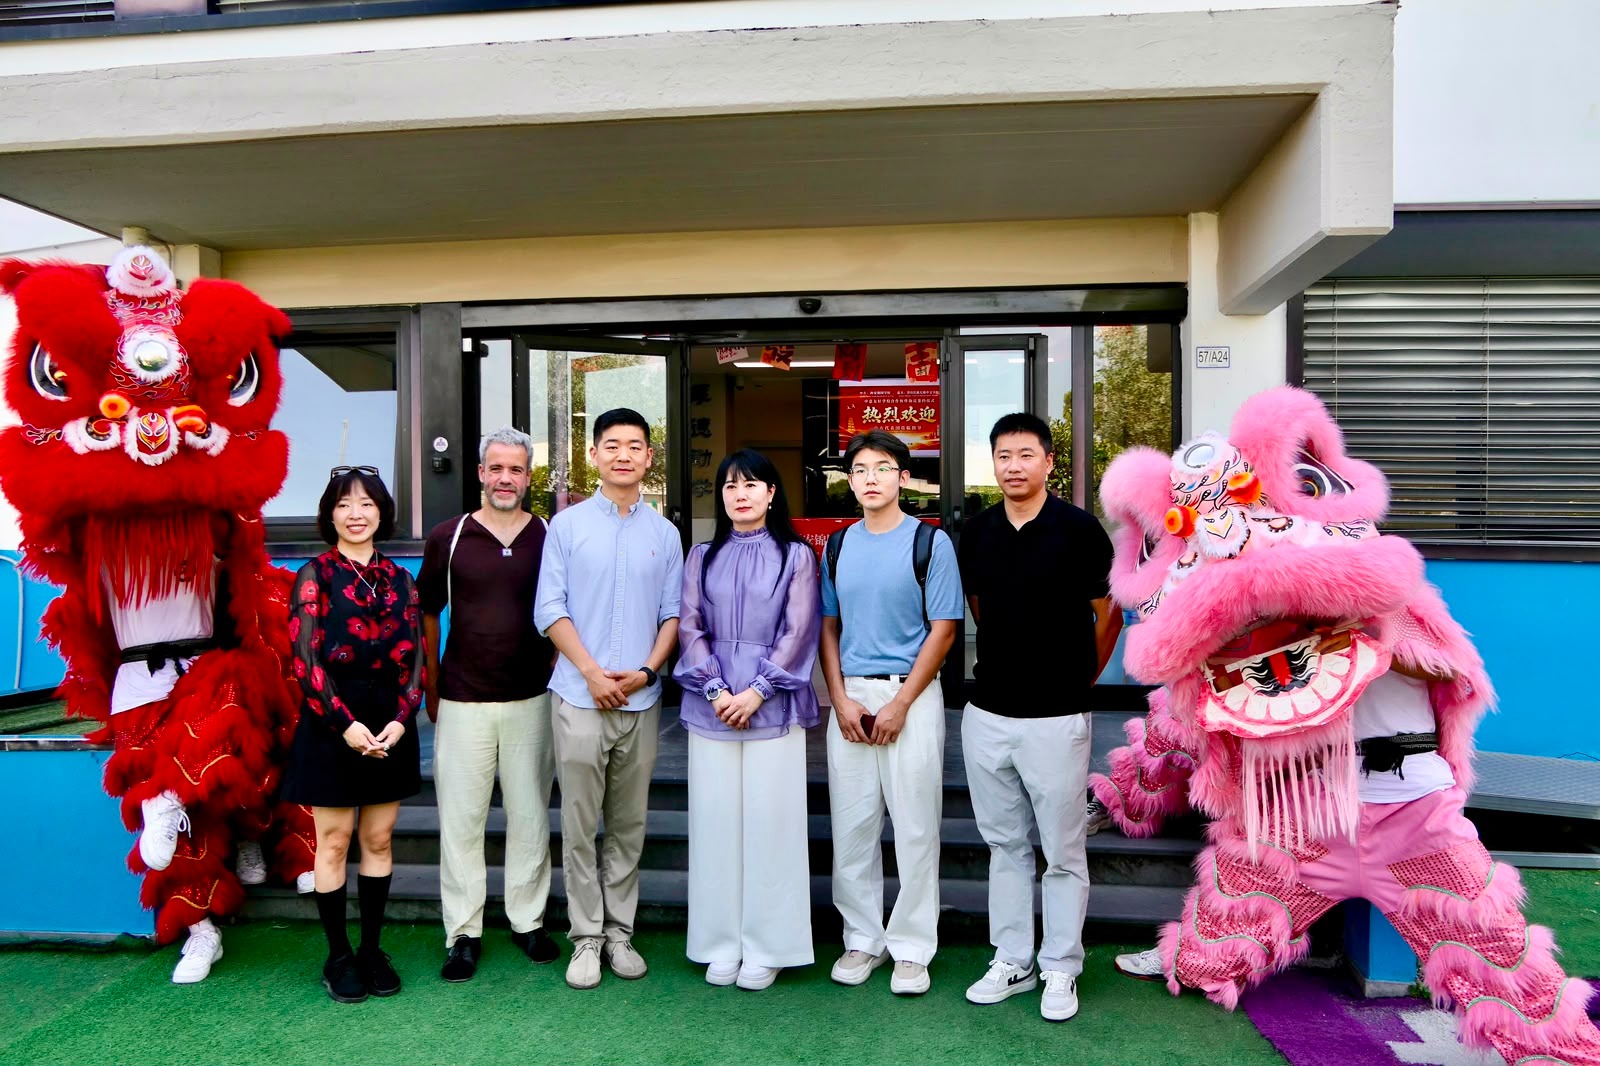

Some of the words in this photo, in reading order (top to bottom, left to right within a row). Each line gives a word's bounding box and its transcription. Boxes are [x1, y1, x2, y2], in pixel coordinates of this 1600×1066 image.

[1198, 350, 1228, 363] 57/A24
[862, 405, 936, 424] 热烈欢迎
